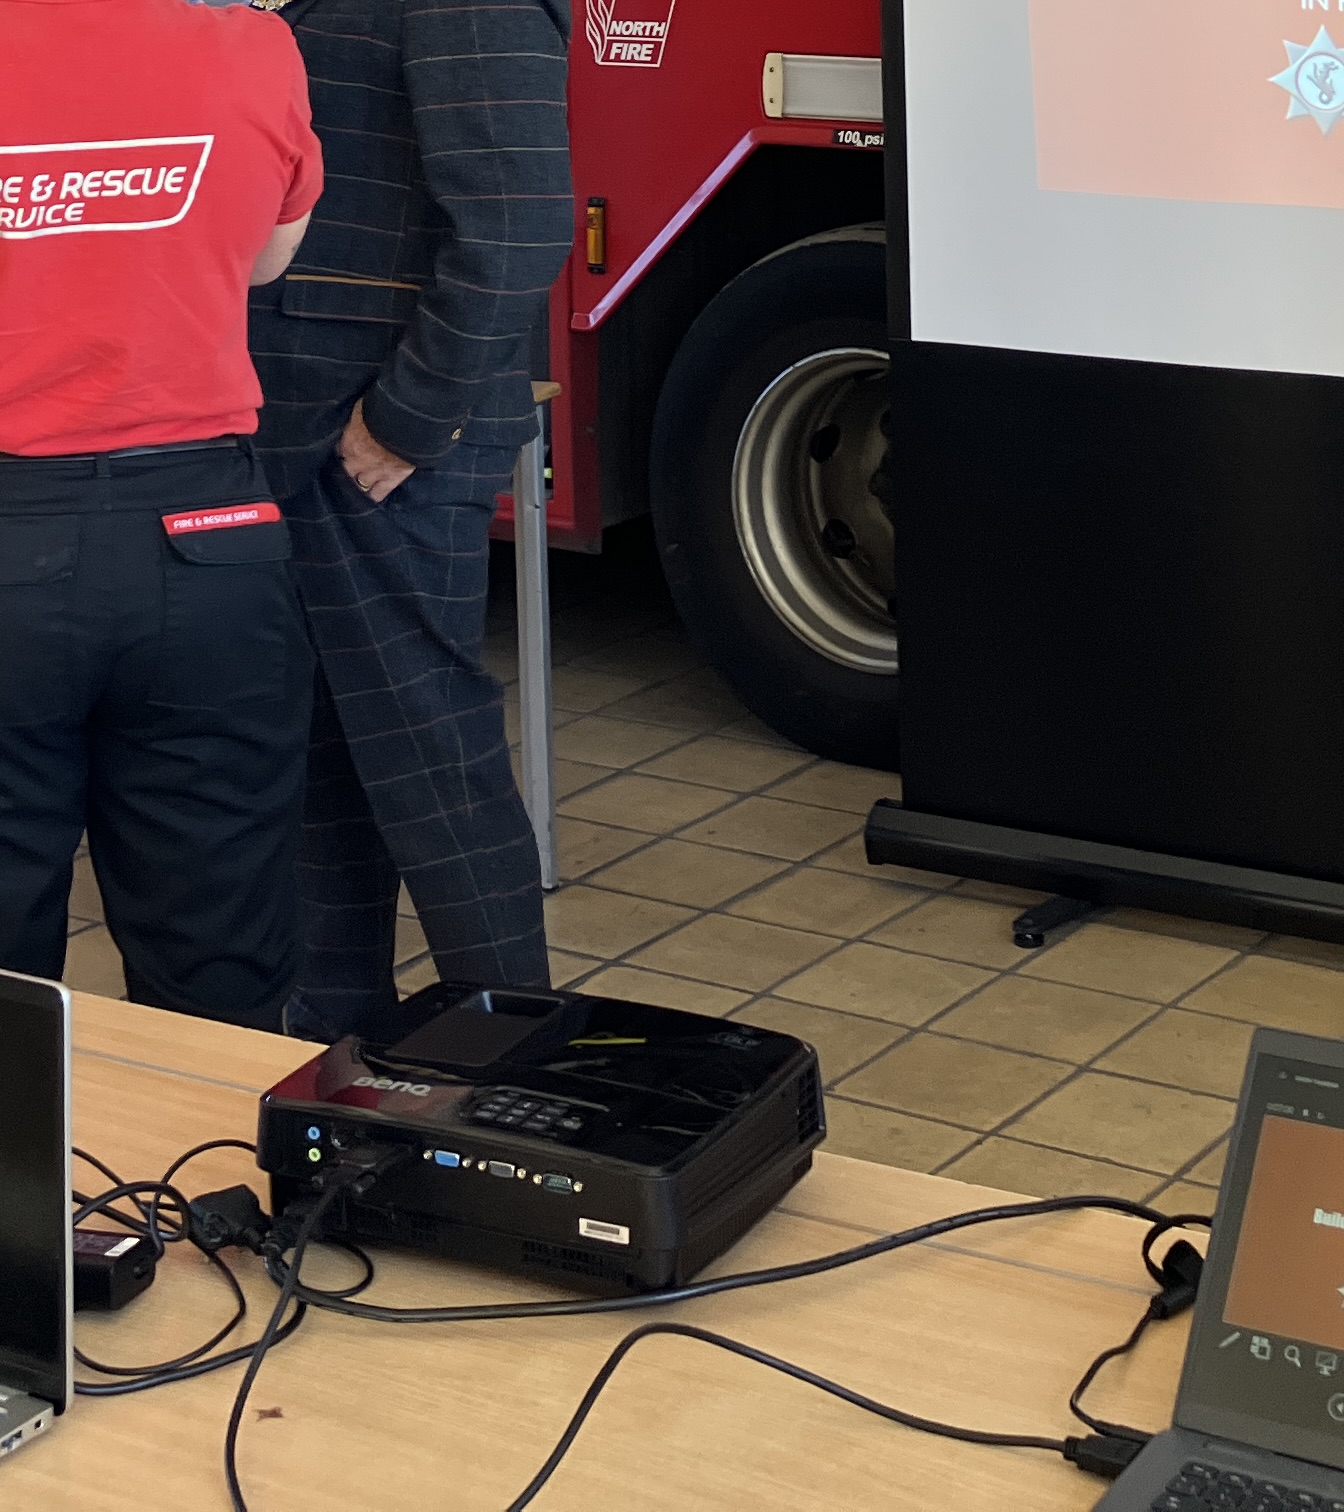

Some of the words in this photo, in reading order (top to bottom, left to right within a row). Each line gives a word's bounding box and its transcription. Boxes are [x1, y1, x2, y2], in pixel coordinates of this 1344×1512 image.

[609, 21, 666, 36] NORTH
[609, 43, 654, 61] FIRE
[838, 130, 860, 143] 100
[865, 133, 884, 147] psi
[31, 174, 56, 202] &
[59, 166, 187, 199] RESCUE
